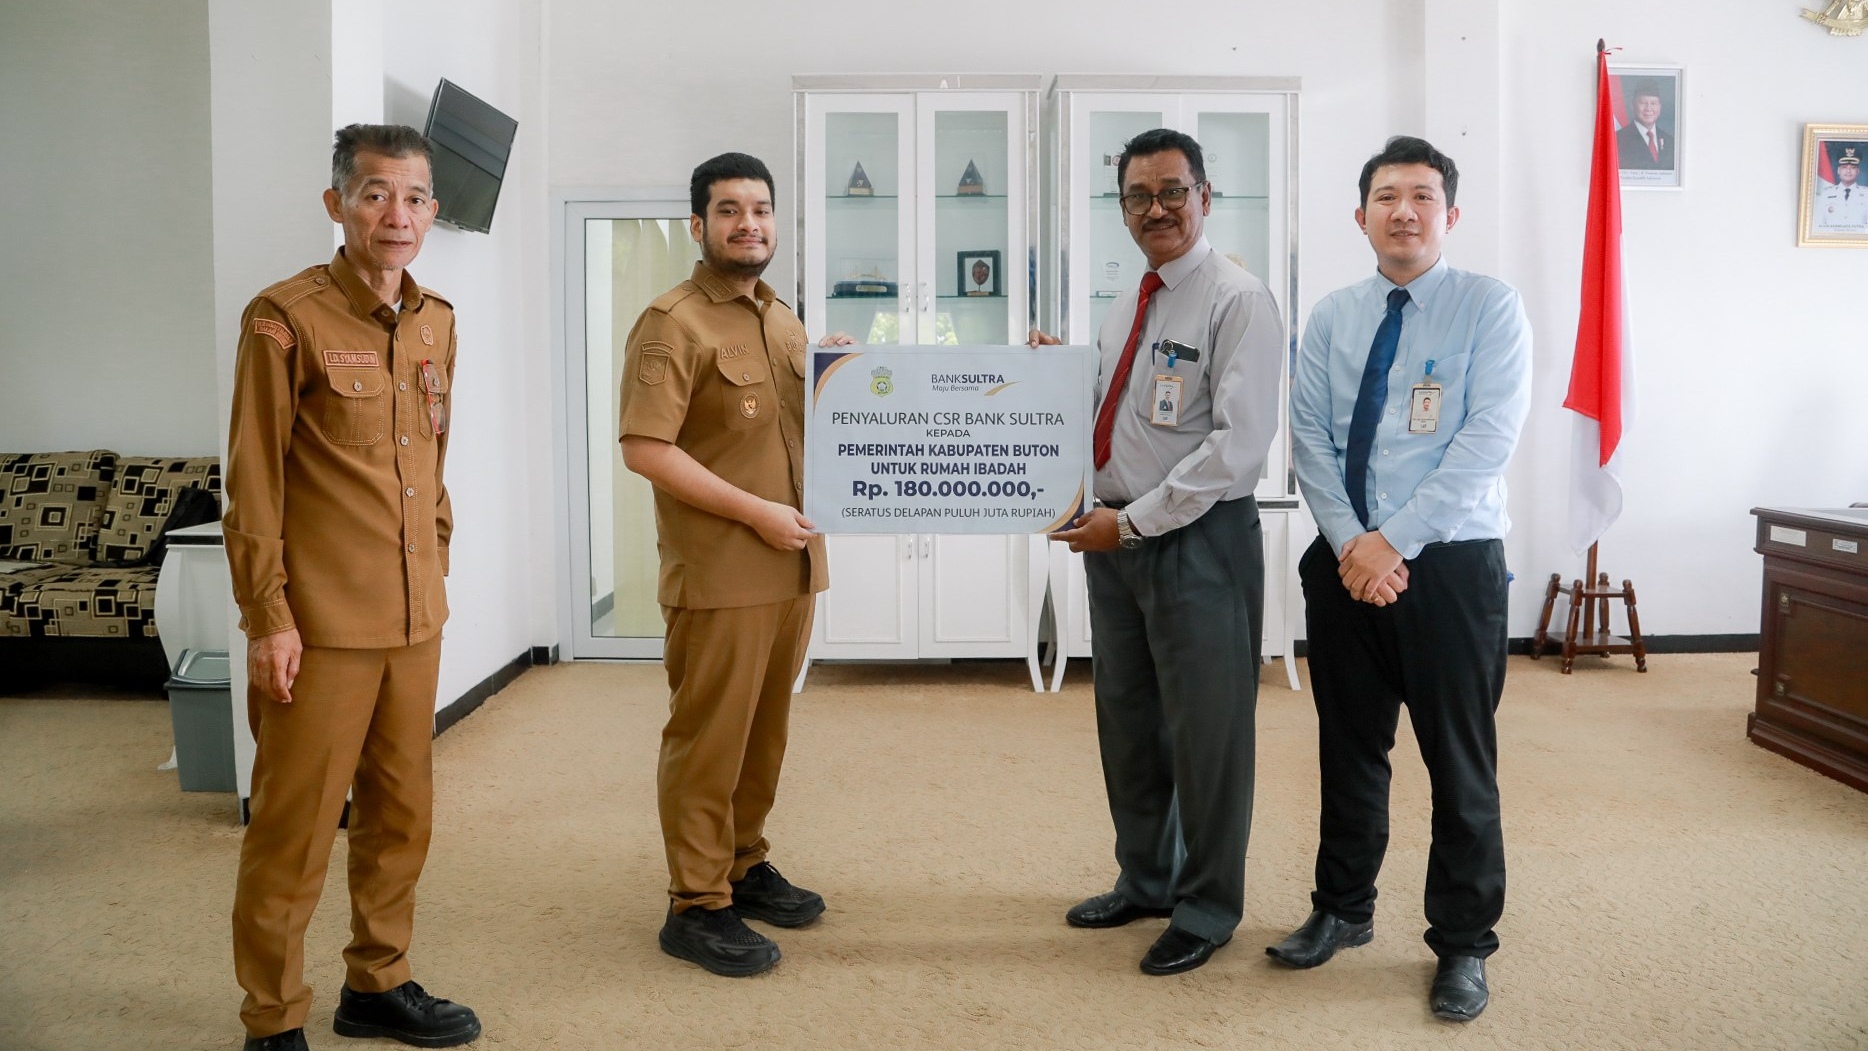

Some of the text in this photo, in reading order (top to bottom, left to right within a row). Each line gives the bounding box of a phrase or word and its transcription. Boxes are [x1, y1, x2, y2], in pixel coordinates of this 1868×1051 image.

[721, 344, 750, 360] ALVIN
[931, 373, 1005, 384] BANKSULTRA
[931, 385, 949, 393] Maju
[832, 412, 1065, 426] PENYALURAN CSR BANK SULTRA
[926, 429, 971, 438] KEPADA
[838, 444, 1060, 457] PEMERINTAH KABUPATEN BUTON
[871, 462, 1027, 475] UNTUK RUMAH IBADAH
[852, 480, 1045, 500] Rp. 180.000.000,-
[841, 507, 1056, 519] (SERATUS DELAPAN PULUH JUTA RUPIAH)
